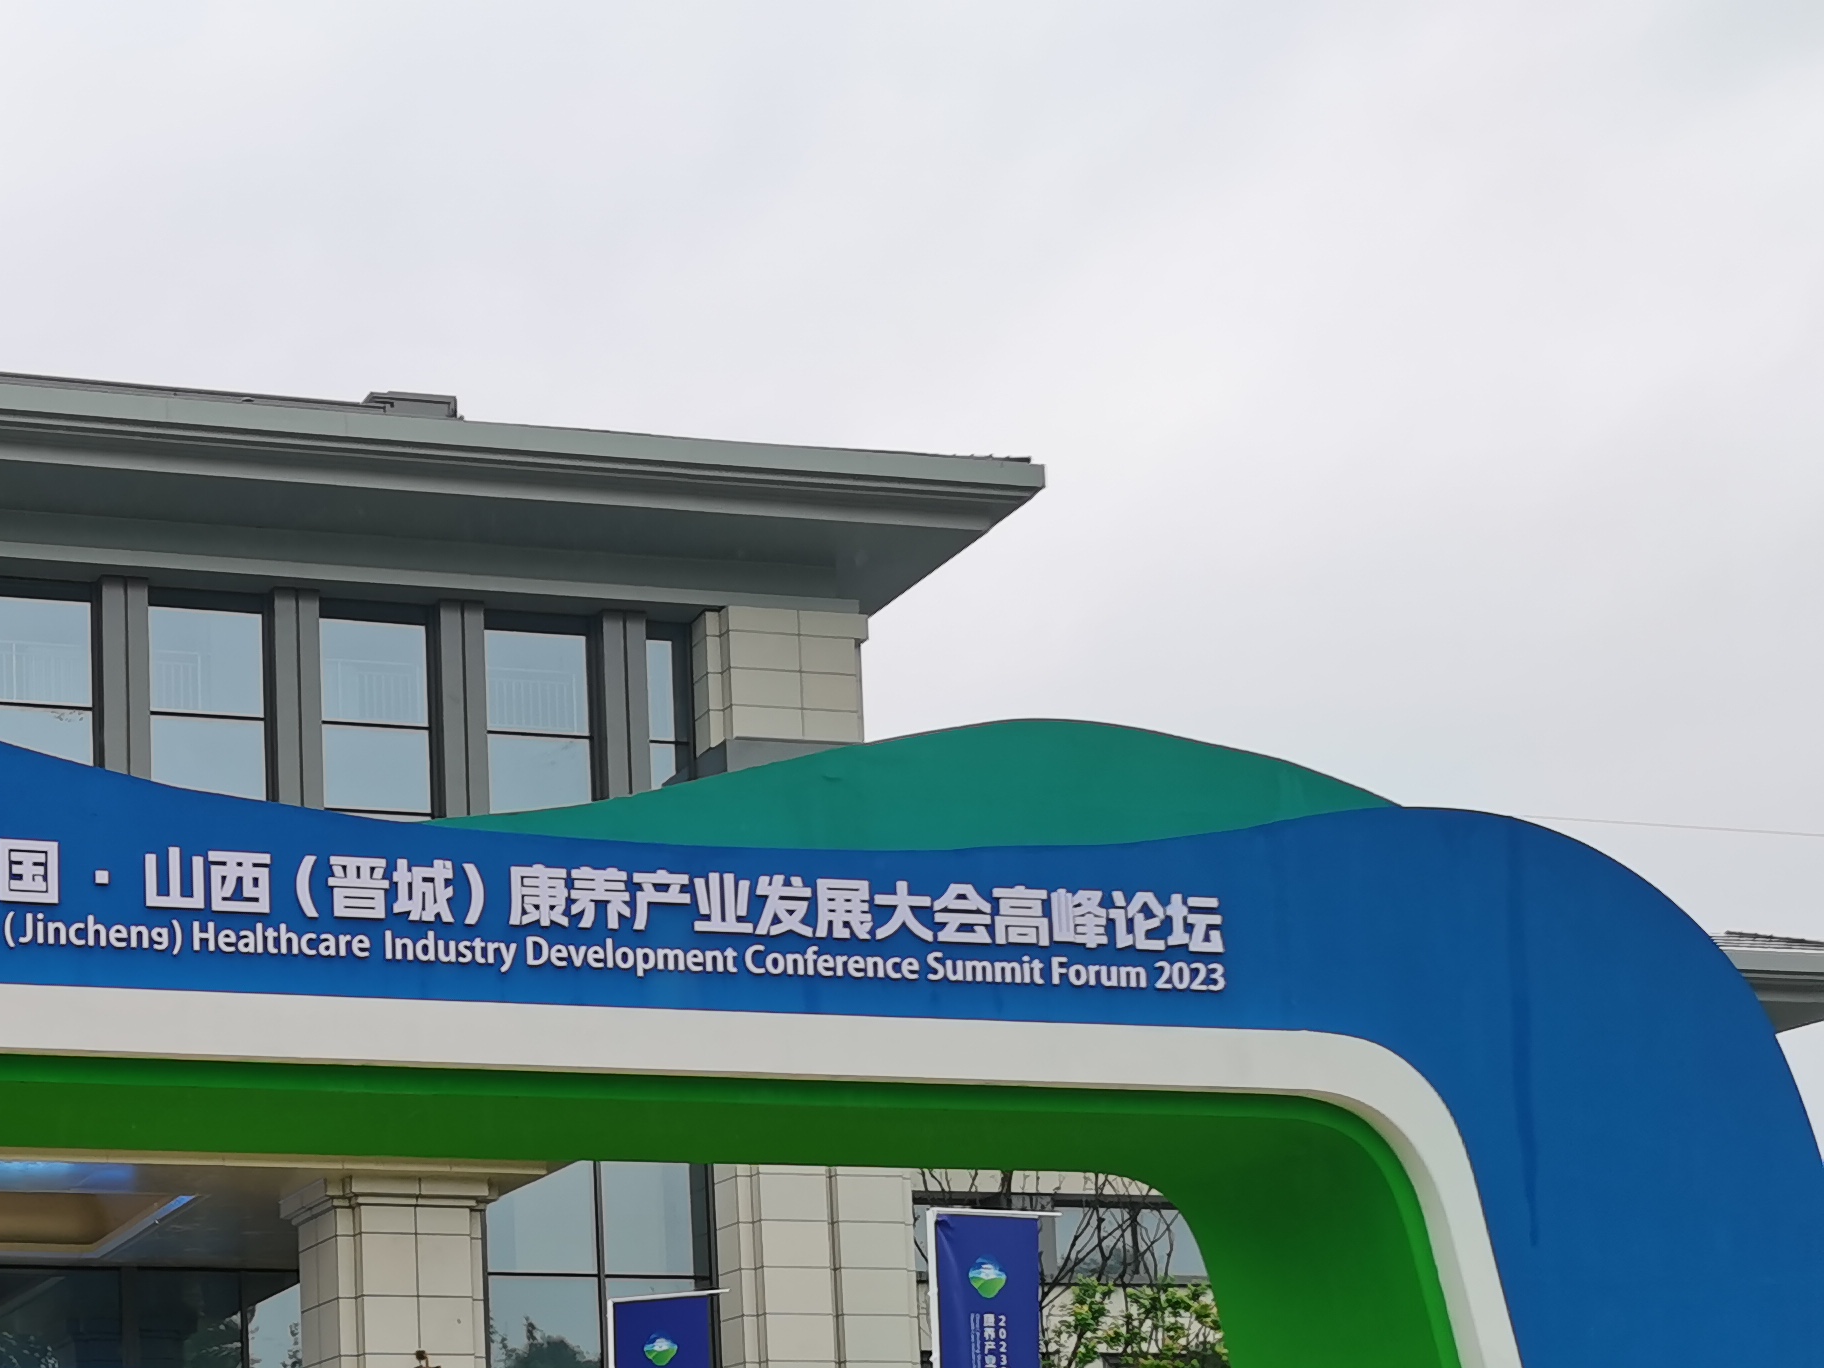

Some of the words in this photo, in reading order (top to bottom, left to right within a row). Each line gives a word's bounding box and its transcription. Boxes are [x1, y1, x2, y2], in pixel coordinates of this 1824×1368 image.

[4, 911, 182, 955] (Jincheng)
[192, 920, 371, 958] Healthcare
[384, 929, 518, 973] Industry
[525, 935, 738, 977] Development
[744, 944, 920, 980] Conference
[926, 951, 1045, 985] Summit
[1051, 956, 1147, 988] Forum
[1154, 960, 1226, 991] 2023
